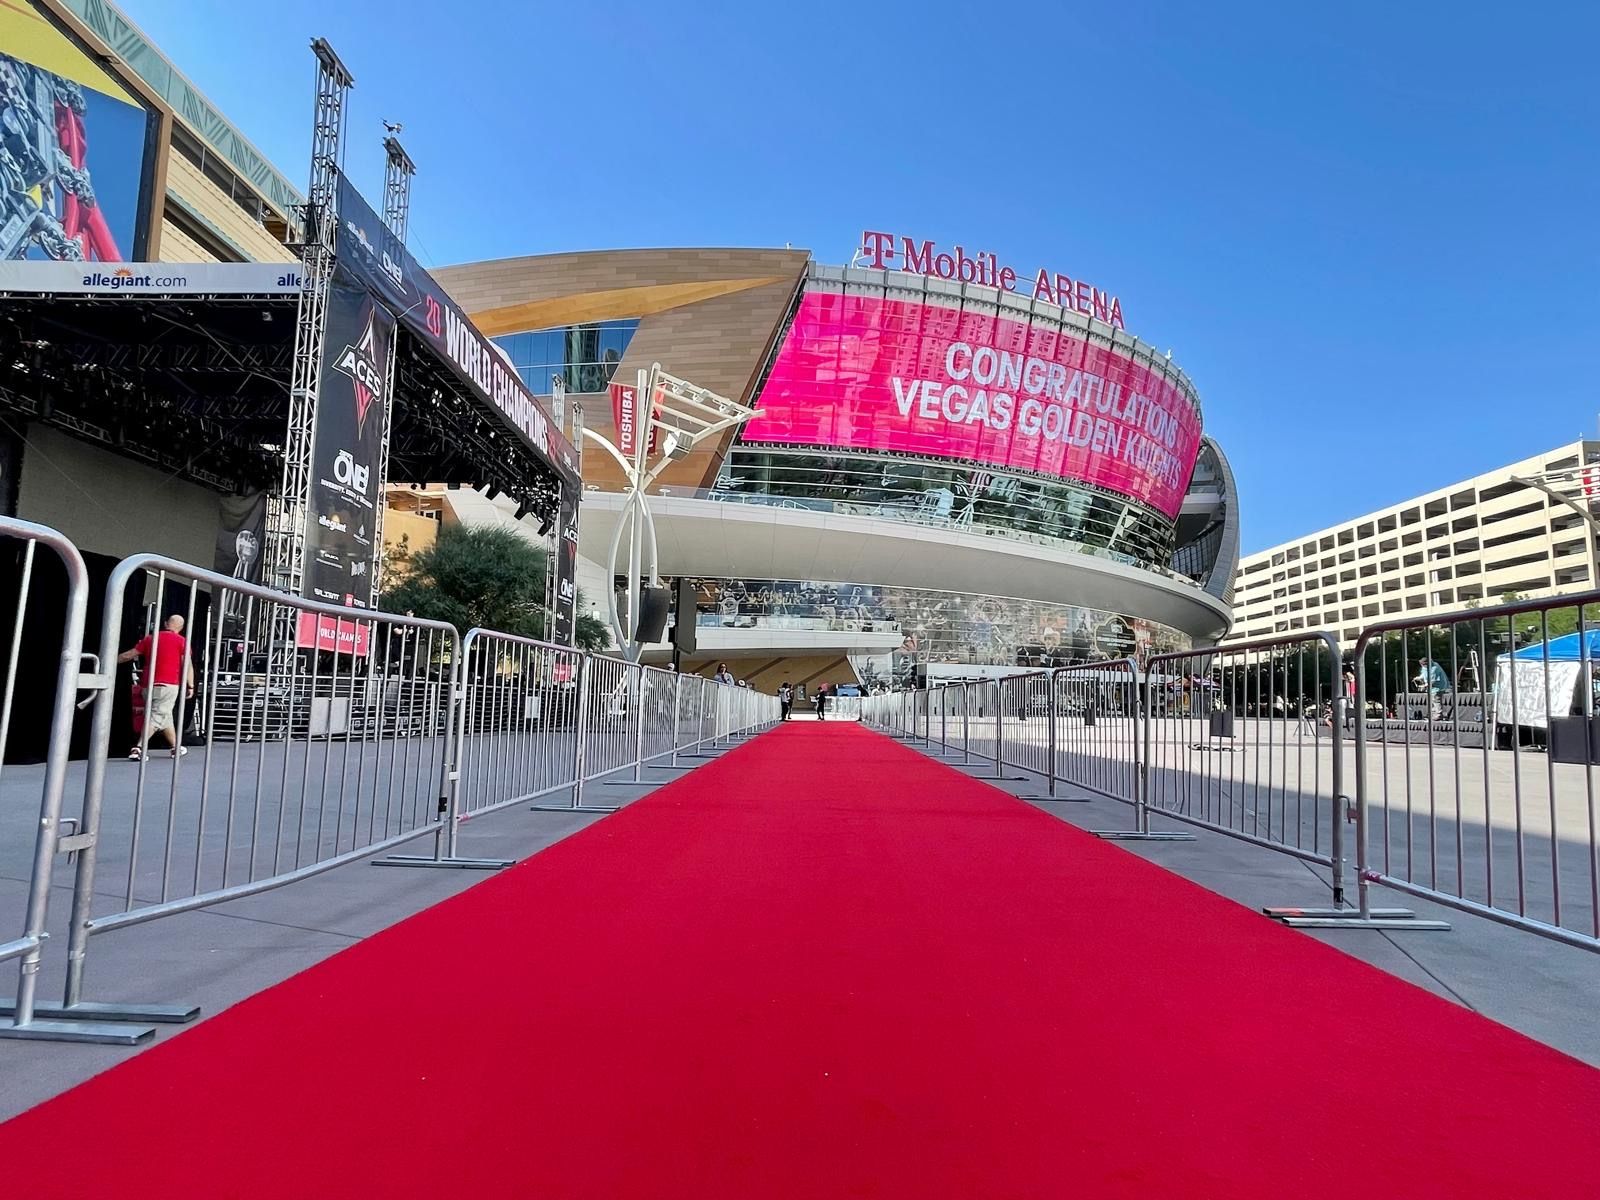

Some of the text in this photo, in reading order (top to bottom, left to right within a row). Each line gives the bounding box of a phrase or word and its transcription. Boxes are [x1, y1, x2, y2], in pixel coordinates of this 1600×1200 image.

[83, 272, 187, 290] allegiant.com
[1032, 268, 1125, 330] ARENA
[340, 351, 381, 397] ACES
[426, 295, 440, 337] 20
[444, 304, 491, 397] WORLD
[493, 361, 548, 455] CHAMPIONS
[945, 341, 1178, 449] CONGRATULATIONS
[621, 390, 633, 451] TOSHIBA
[892, 377, 1182, 490] VEGAS GOLDEN KNIGHTS
[563, 527, 577, 543] ACE
[317, 626, 336, 639] ORLD
